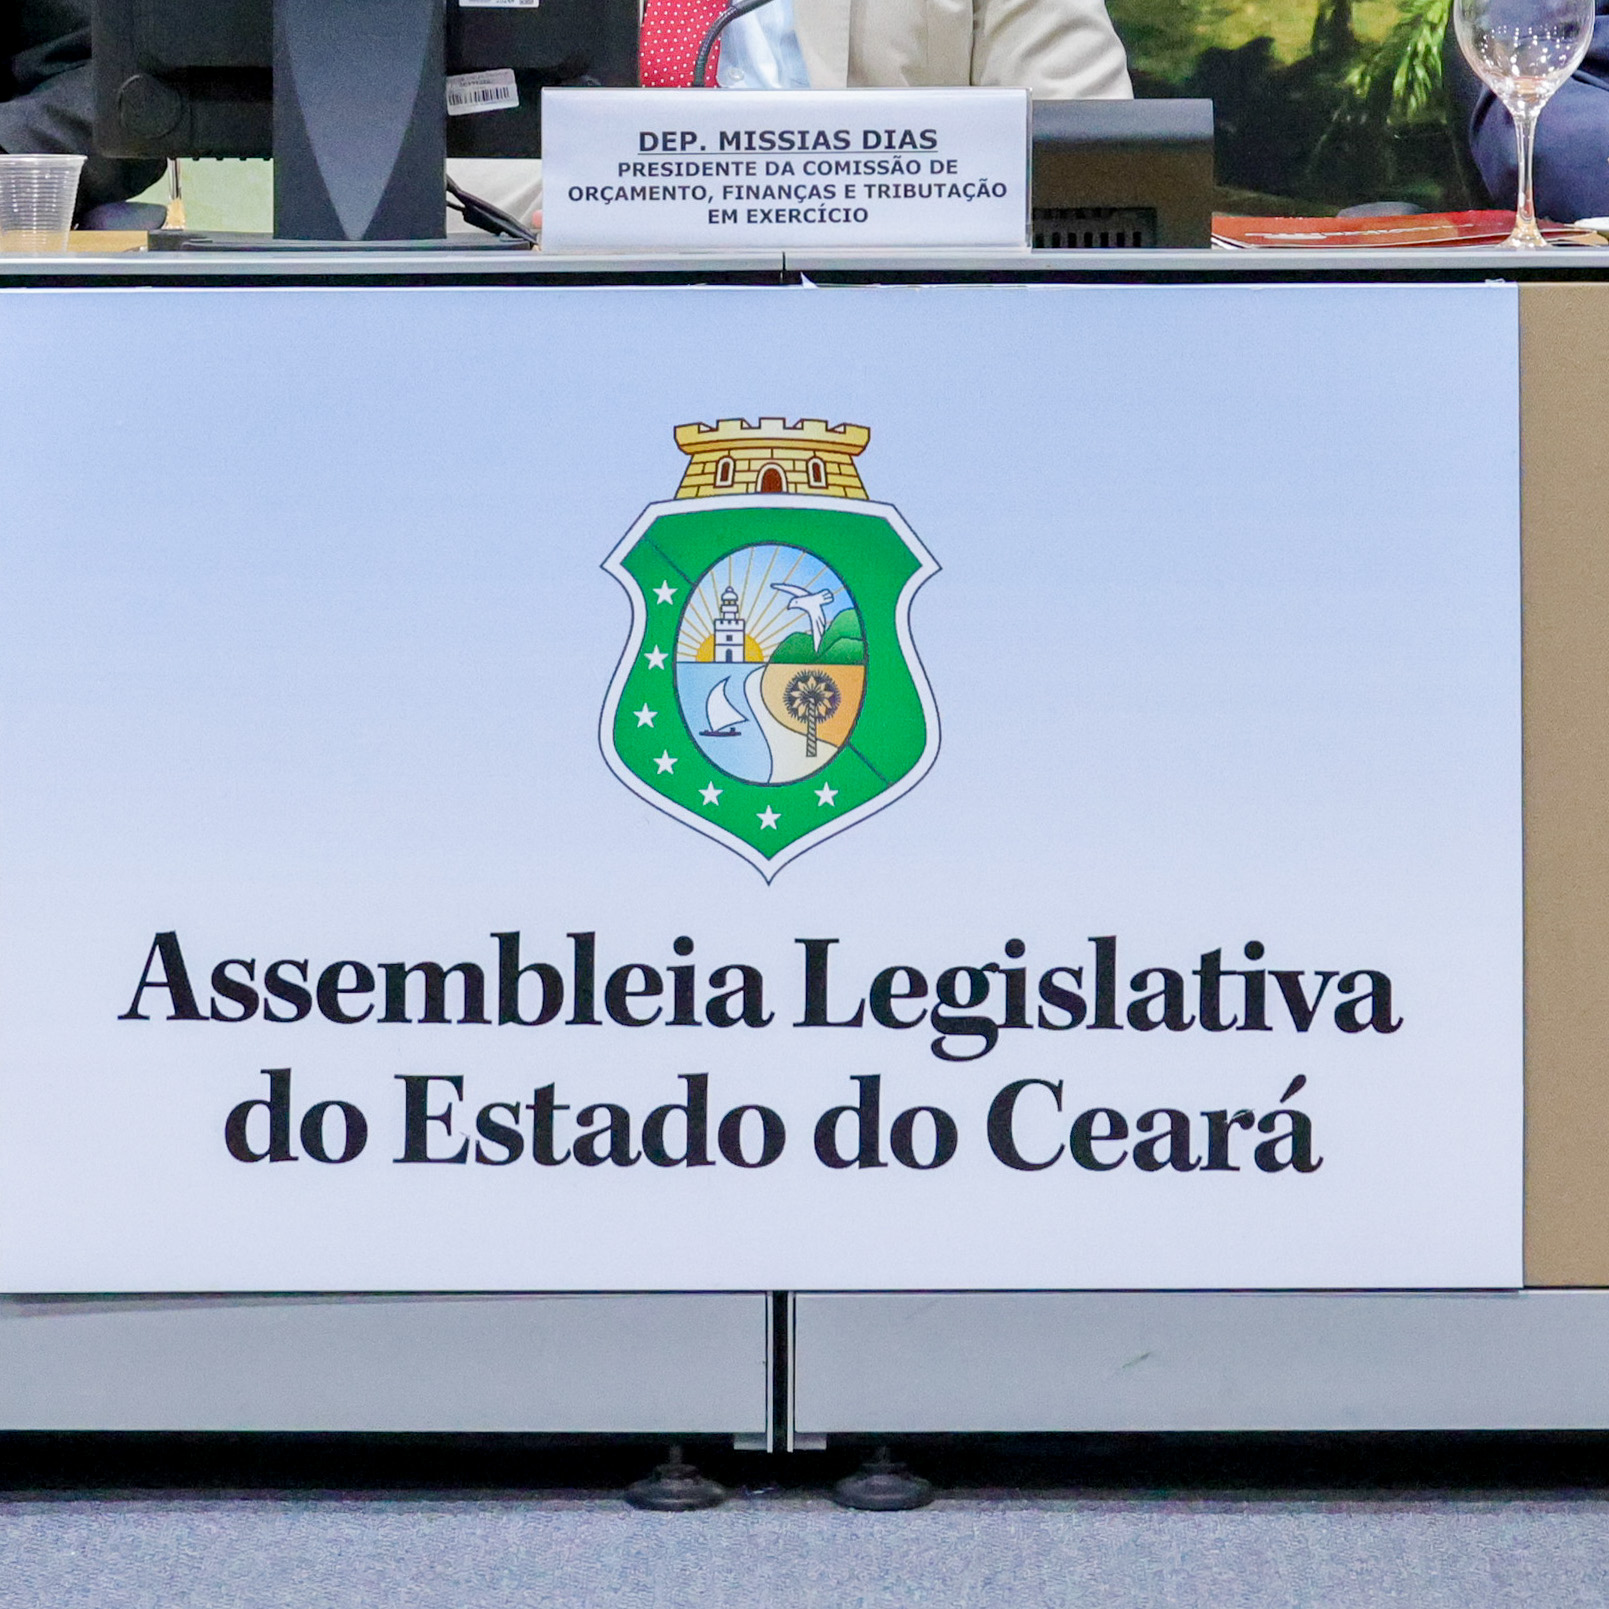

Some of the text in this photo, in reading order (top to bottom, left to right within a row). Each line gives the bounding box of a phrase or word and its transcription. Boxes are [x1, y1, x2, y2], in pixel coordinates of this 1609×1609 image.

[639, 128, 938, 152] DEP. MISSIAS DIAS
[618, 154, 958, 178] PRESIDENTE DA COMISSÃO DE
[568, 178, 1008, 205] ORÇAMENTO, FINANÇAS E TRIBUTAÇÃO
[708, 202, 869, 225] EM EXERCÍCIO
[116, 929, 1405, 1064] Assembleia Legislativa
[224, 1067, 1324, 1175] do Estado do Ceará
